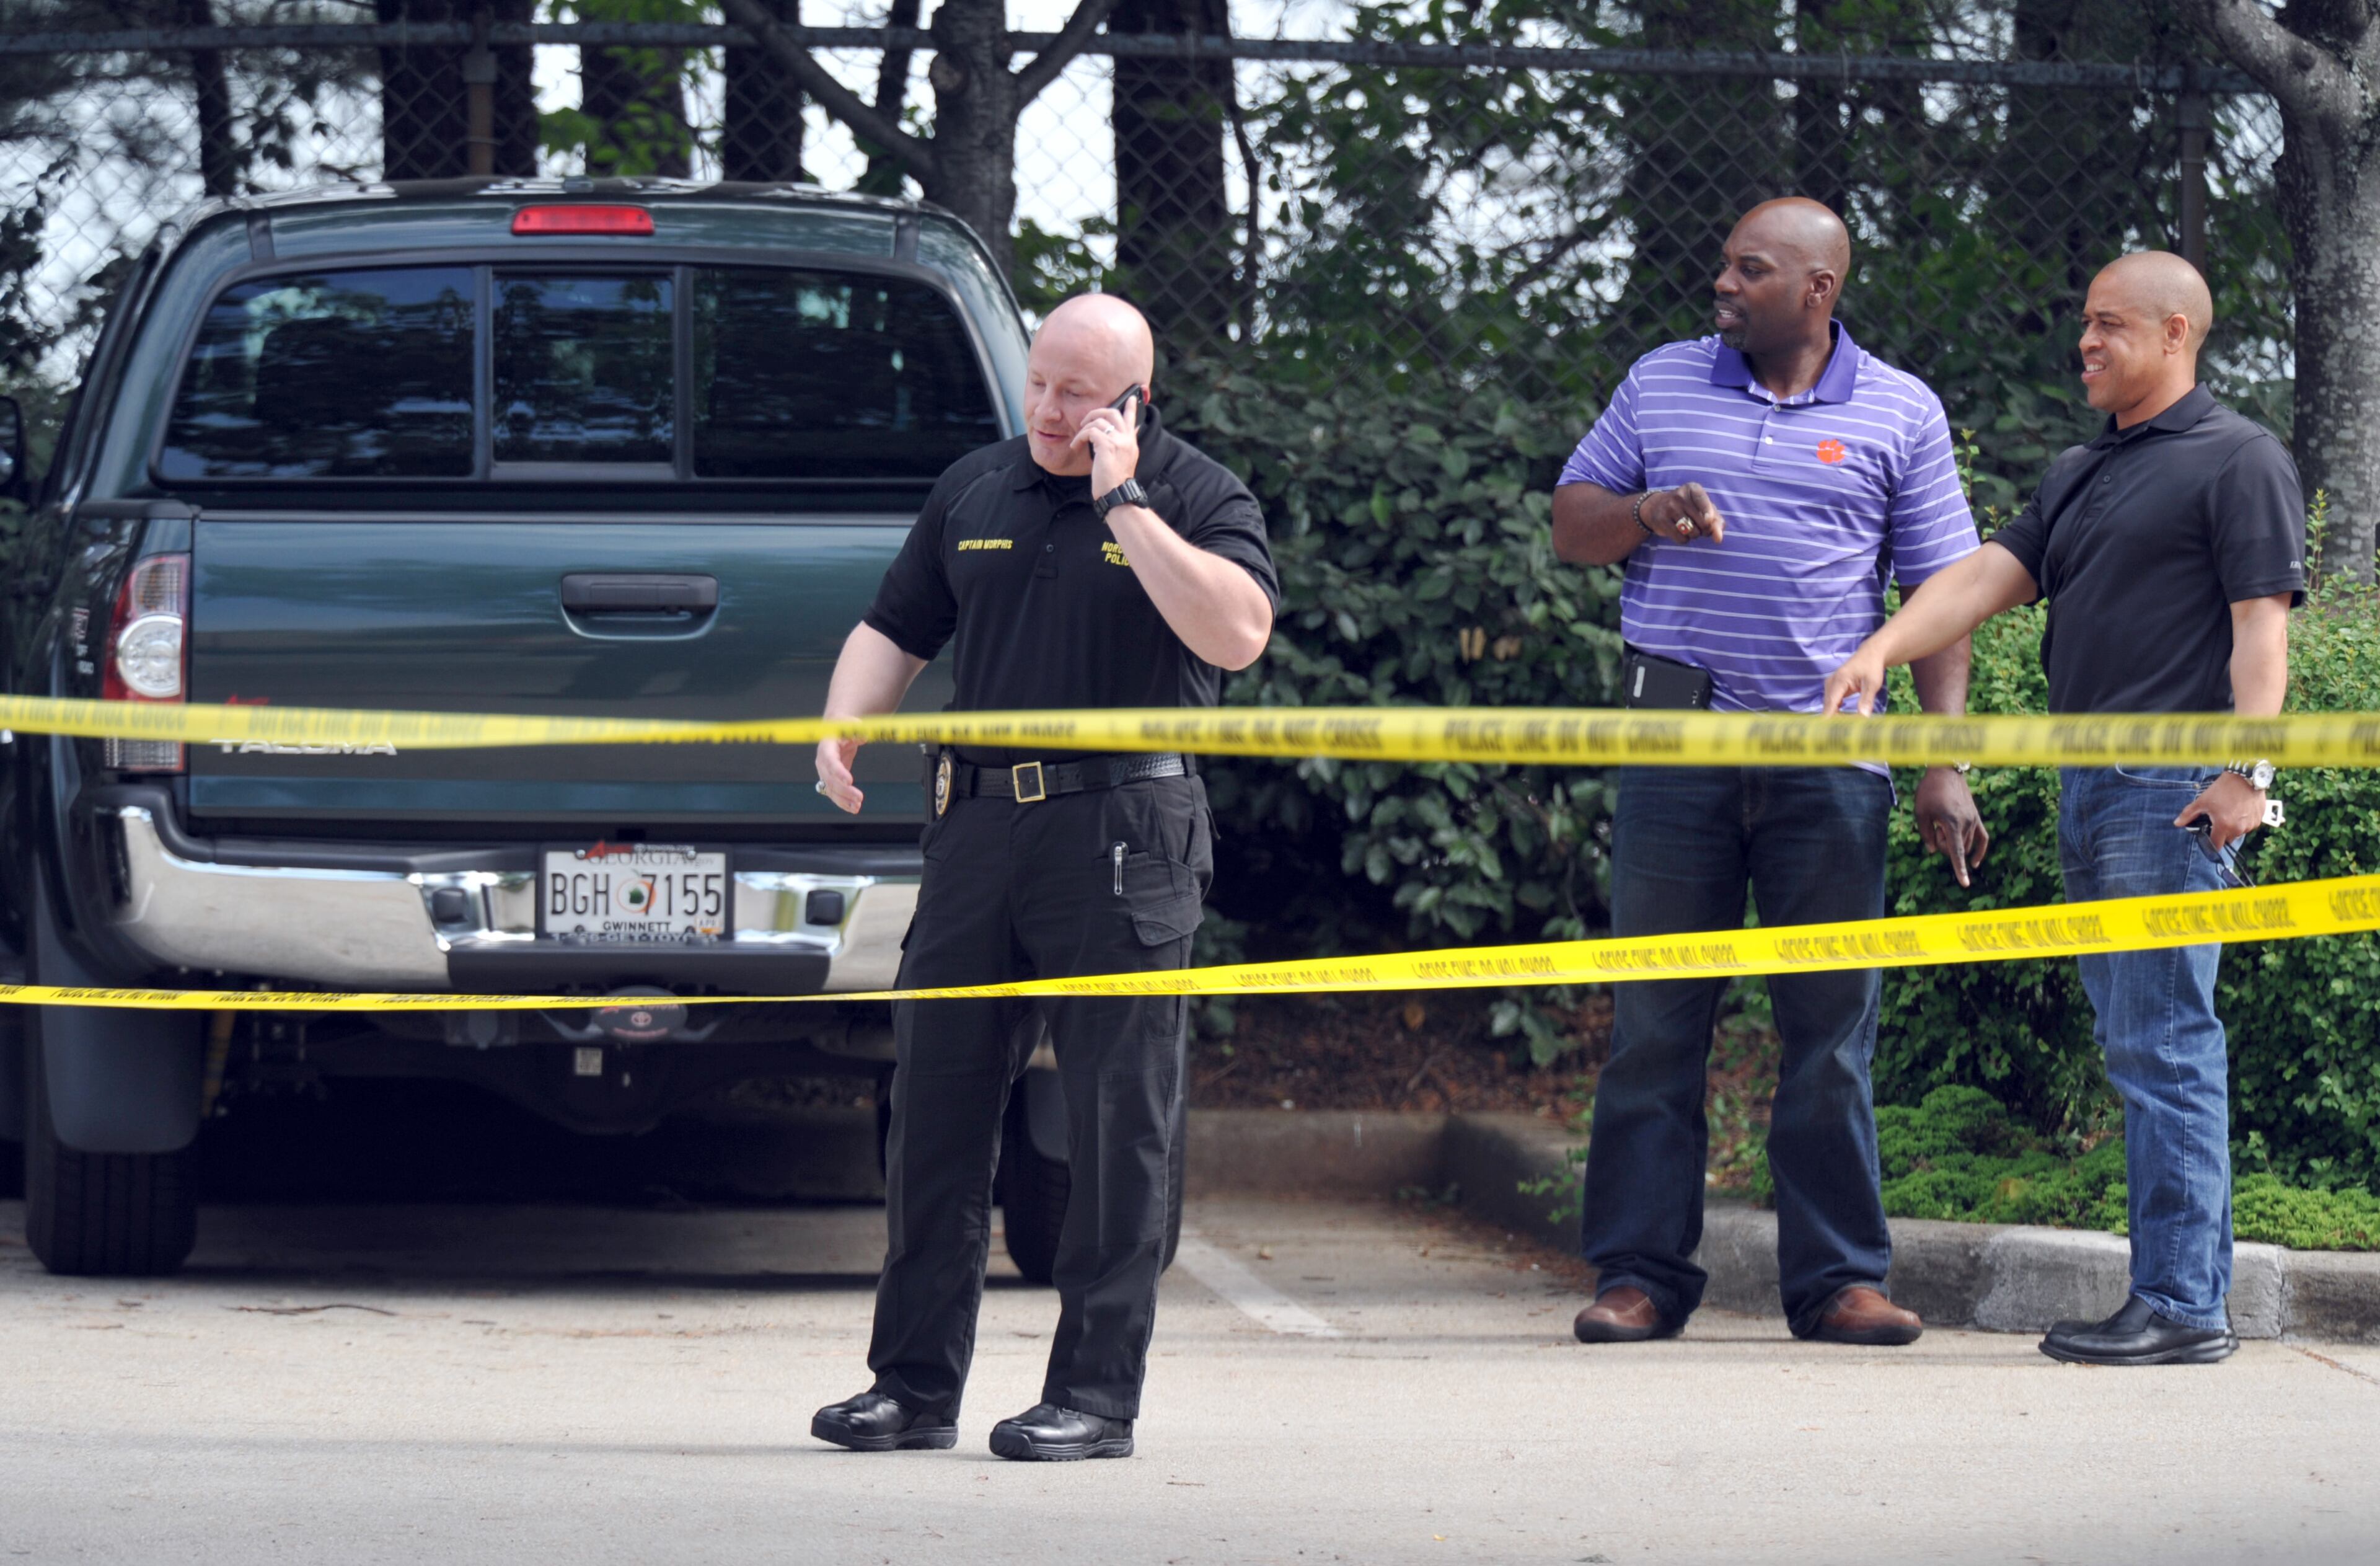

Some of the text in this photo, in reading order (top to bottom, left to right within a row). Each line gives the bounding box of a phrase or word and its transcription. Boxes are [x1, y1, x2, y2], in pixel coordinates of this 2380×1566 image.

[958, 539, 983, 551] CAPTAIN
[1104, 552, 1130, 566] POLIC
[550, 873, 722, 916] BGH 7155
[603, 921, 671, 932] GWINNETT
